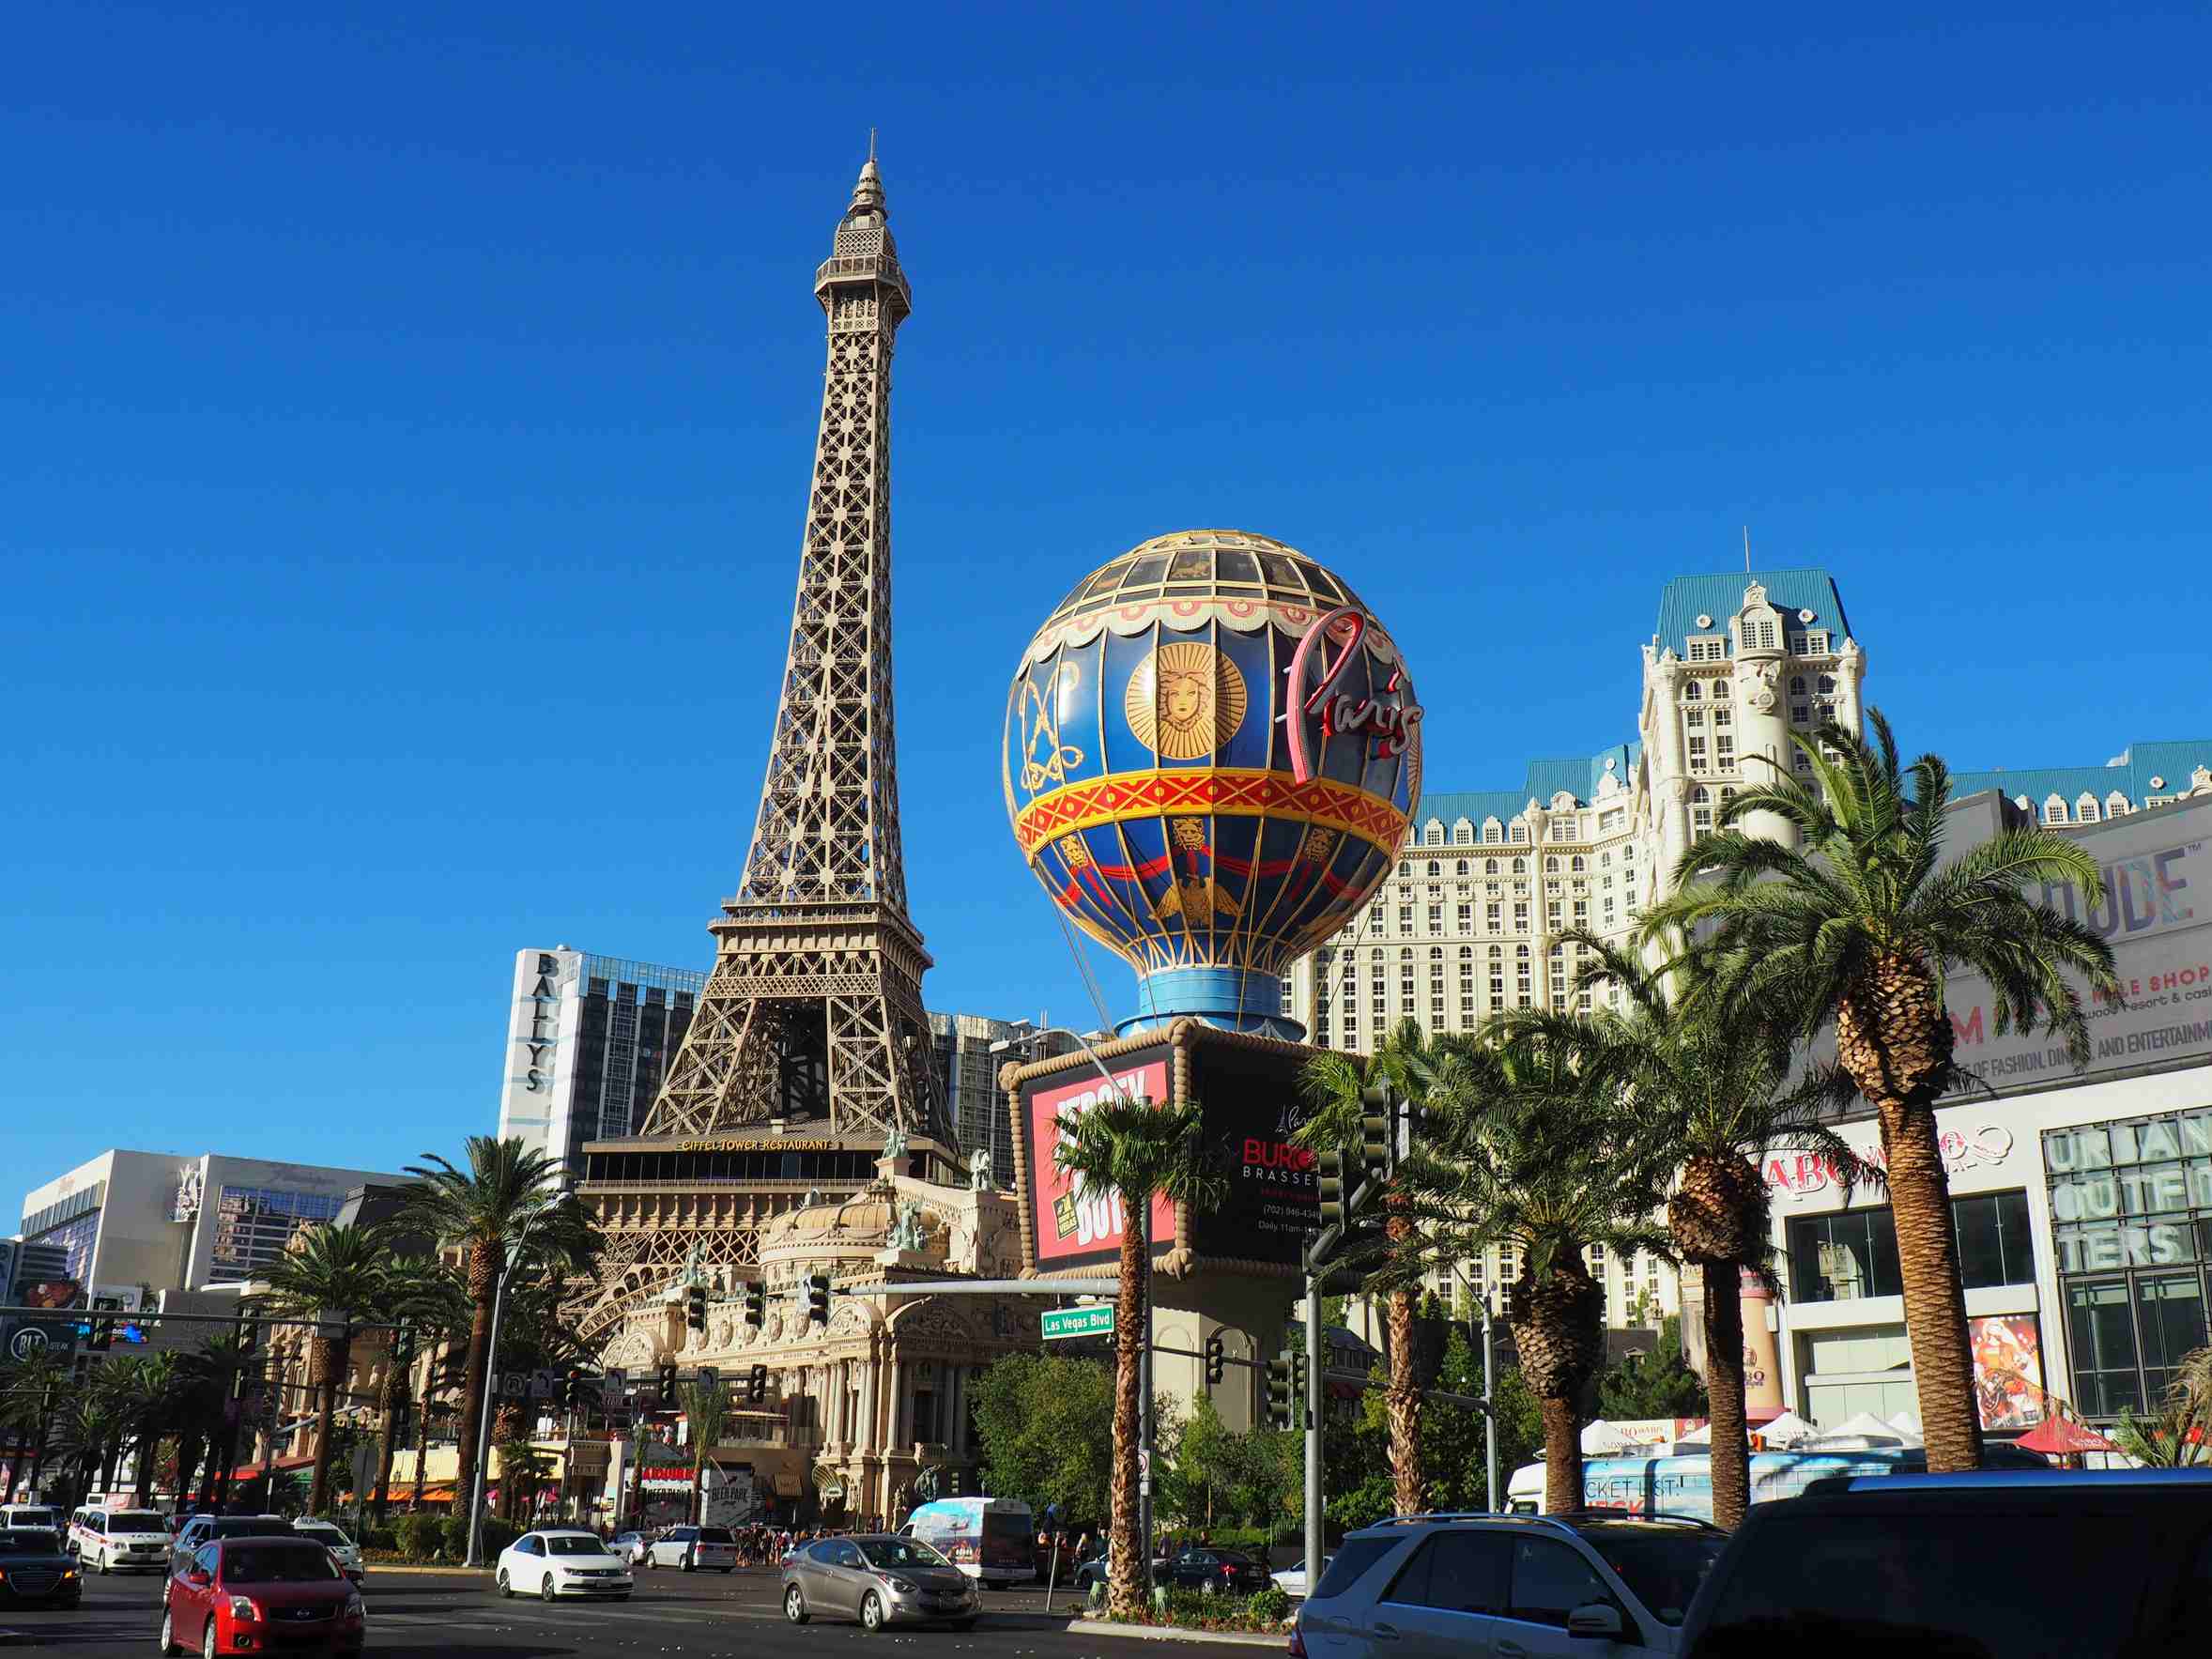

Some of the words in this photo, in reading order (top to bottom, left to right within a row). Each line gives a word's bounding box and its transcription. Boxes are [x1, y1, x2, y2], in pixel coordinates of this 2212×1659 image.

[1286, 607, 1424, 785] Paris
[2127, 1022, 2212, 1054] ENTERTAINM
[682, 1140, 716, 1151] EIFFEL
[720, 1140, 759, 1151] TOWER
[762, 1139, 828, 1150] RESTAURANT
[1242, 1166, 1322, 1188] BRASSE
[1045, 1319, 1060, 1332] Las
[1063, 1315, 1087, 1331] Vegas
[1090, 1312, 1110, 1327] Blvd
[1584, 1479, 1633, 1498] CKET
